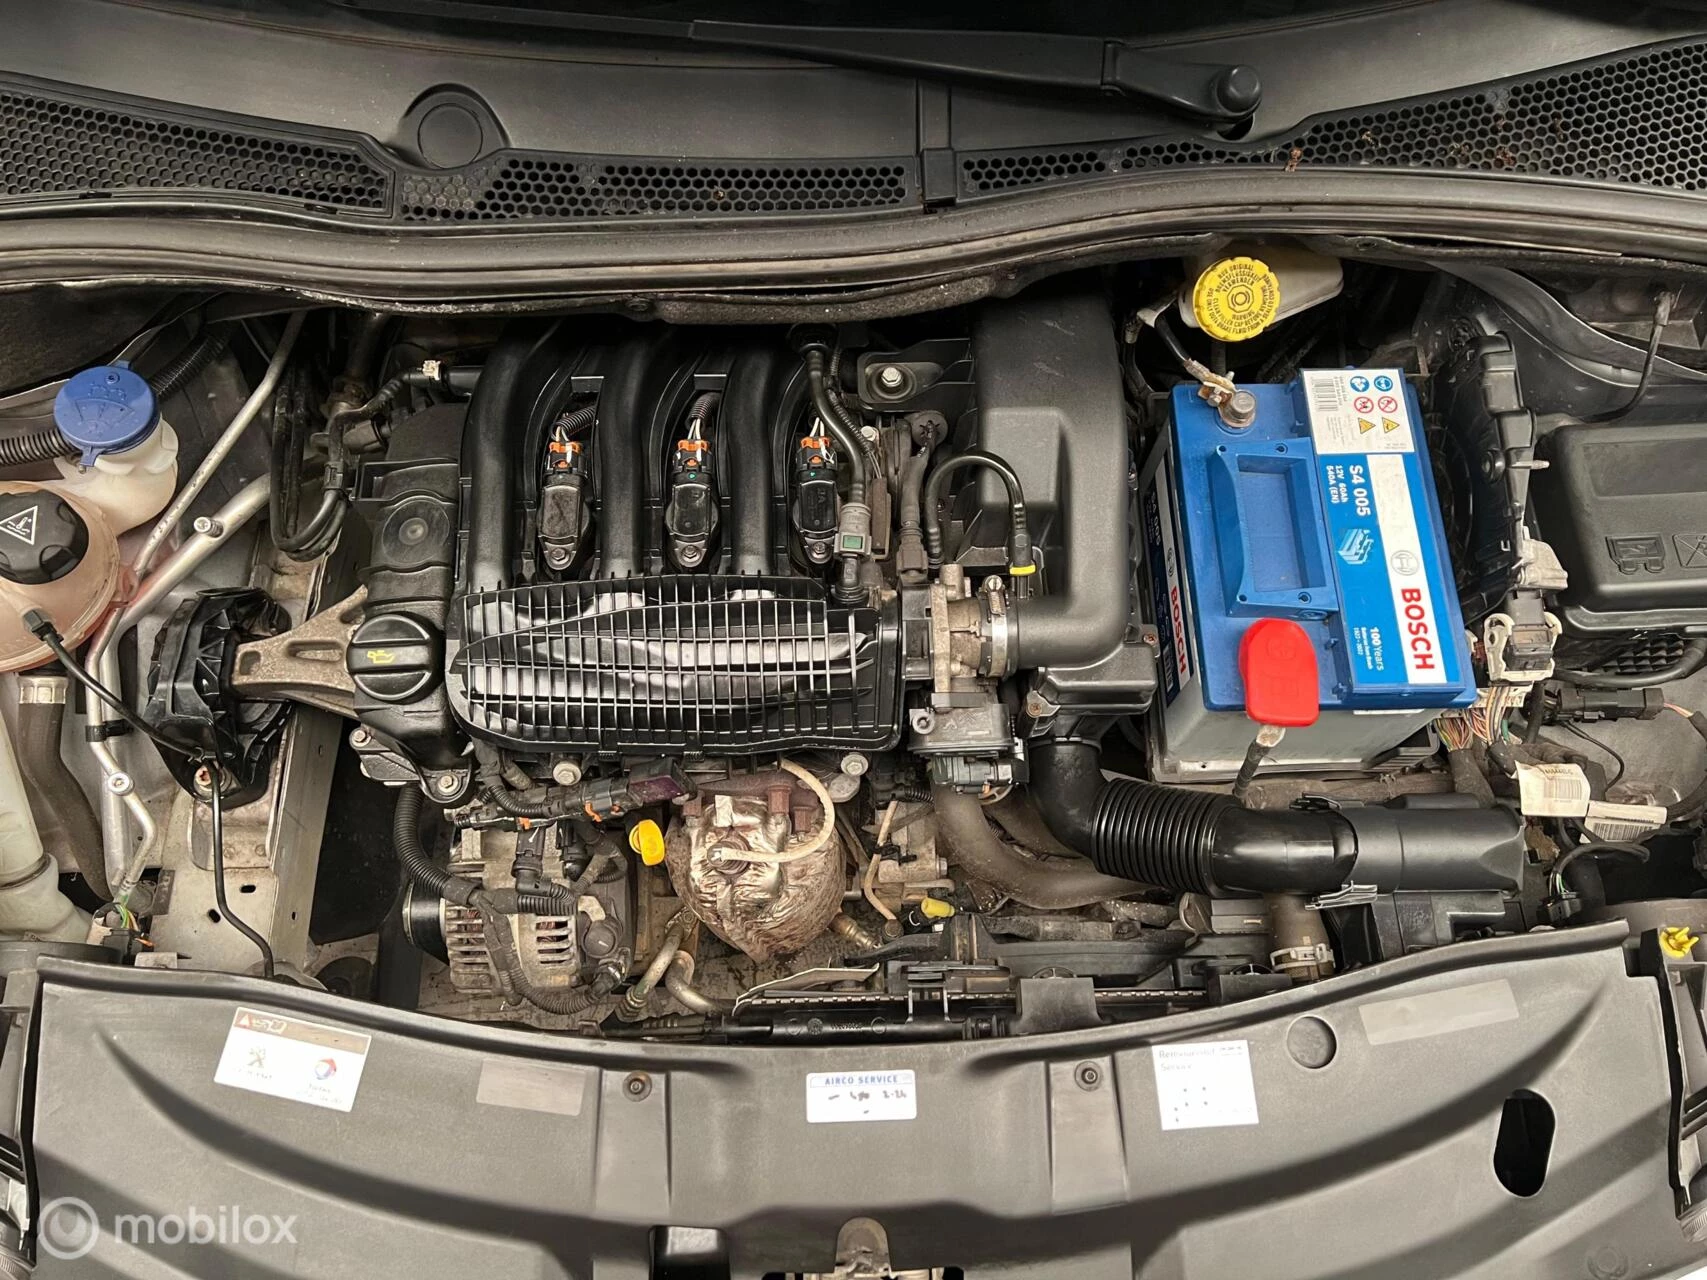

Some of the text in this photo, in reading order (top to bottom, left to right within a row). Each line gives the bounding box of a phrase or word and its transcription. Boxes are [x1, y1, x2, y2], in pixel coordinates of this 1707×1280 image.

[1328, 486, 1340, 504] (EN)
[1335, 465, 1349, 502] 12V 60Ah
[1349, 465, 1372, 516] S4 005
[1170, 585, 1187, 675] BOSCH
[1401, 588, 1436, 670] BOSCH
[825, 1074, 898, 1085] AIRCO SERVICE
